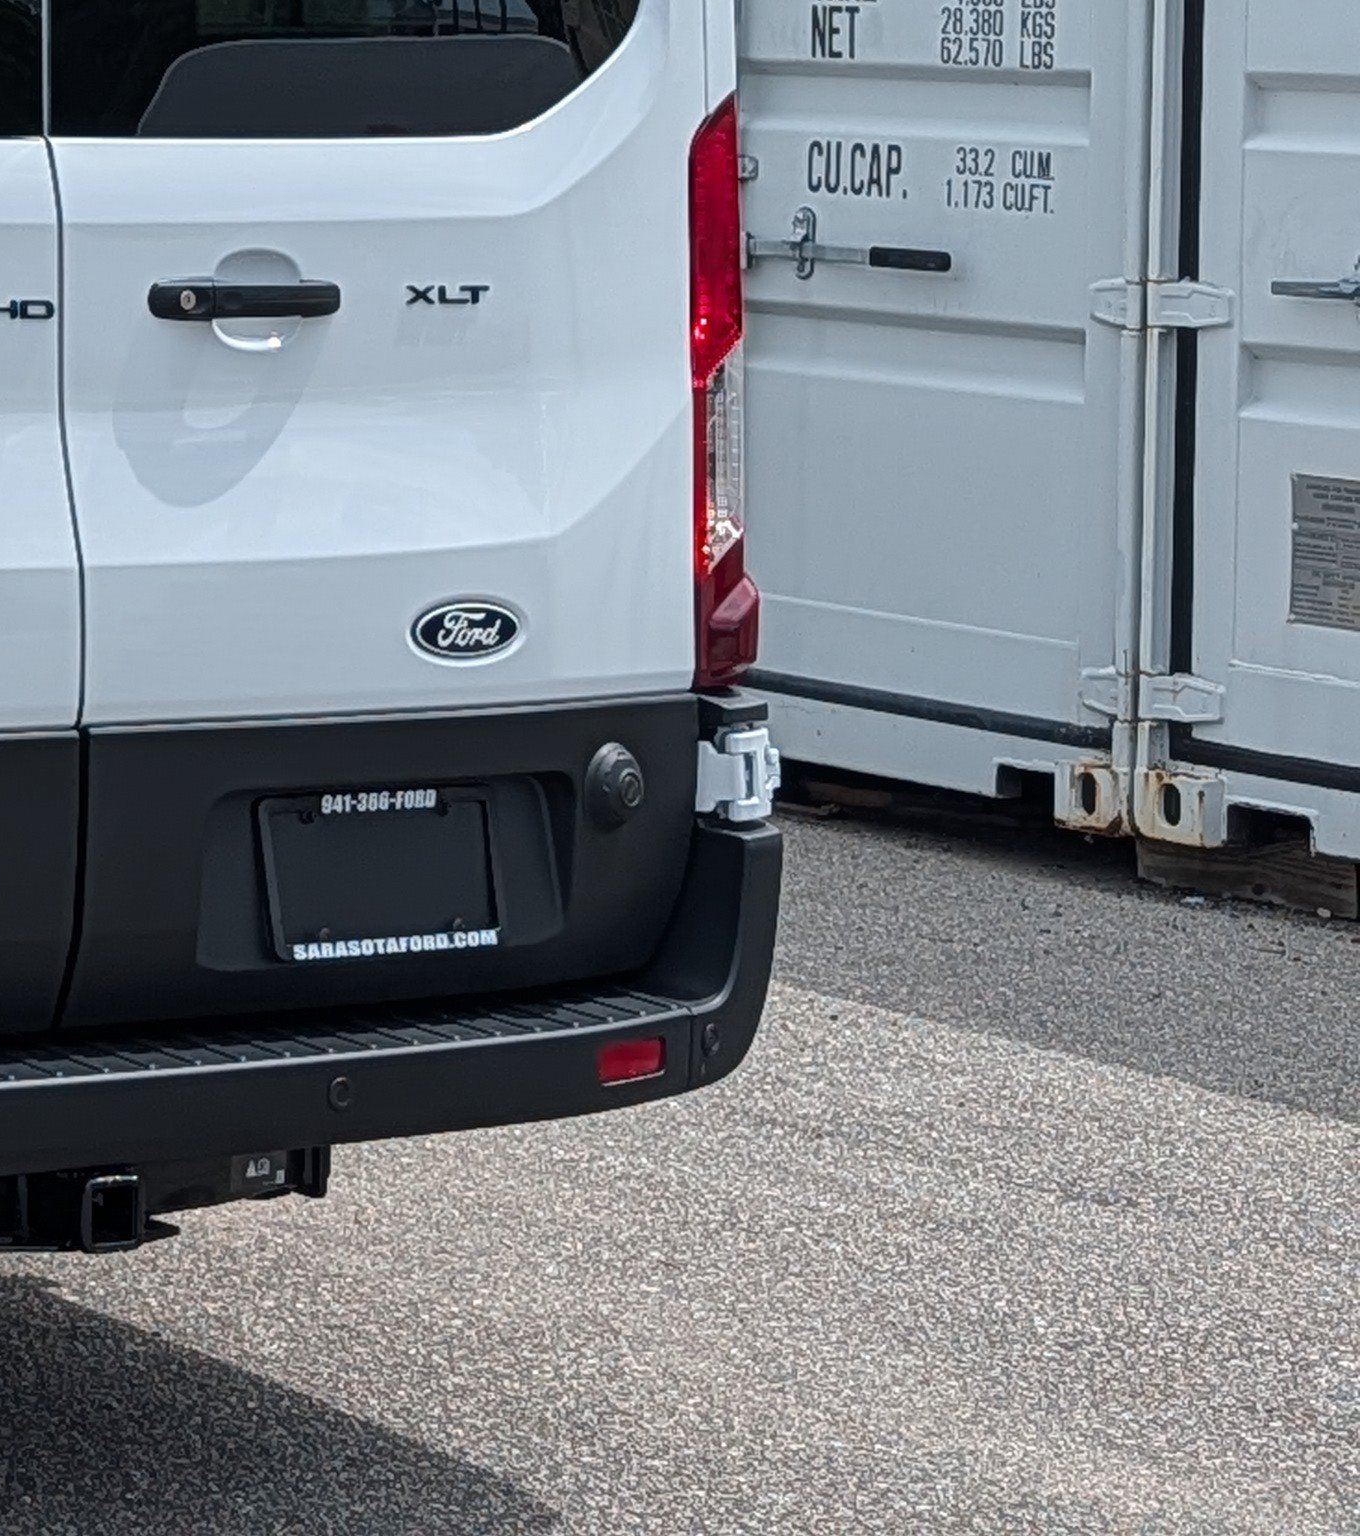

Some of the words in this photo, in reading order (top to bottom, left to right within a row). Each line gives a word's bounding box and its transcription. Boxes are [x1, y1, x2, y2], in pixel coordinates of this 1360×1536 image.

[811, 4, 860, 59] NET
[1020, 10, 1055, 40] KGS
[1019, 40, 1054, 69] LBS
[946, 178, 994, 210] 1.173
[405, 285, 490, 305] XLT
[437, 611, 501, 648] Ford
[293, 929, 499, 961] SARASOTAFORD.COM
